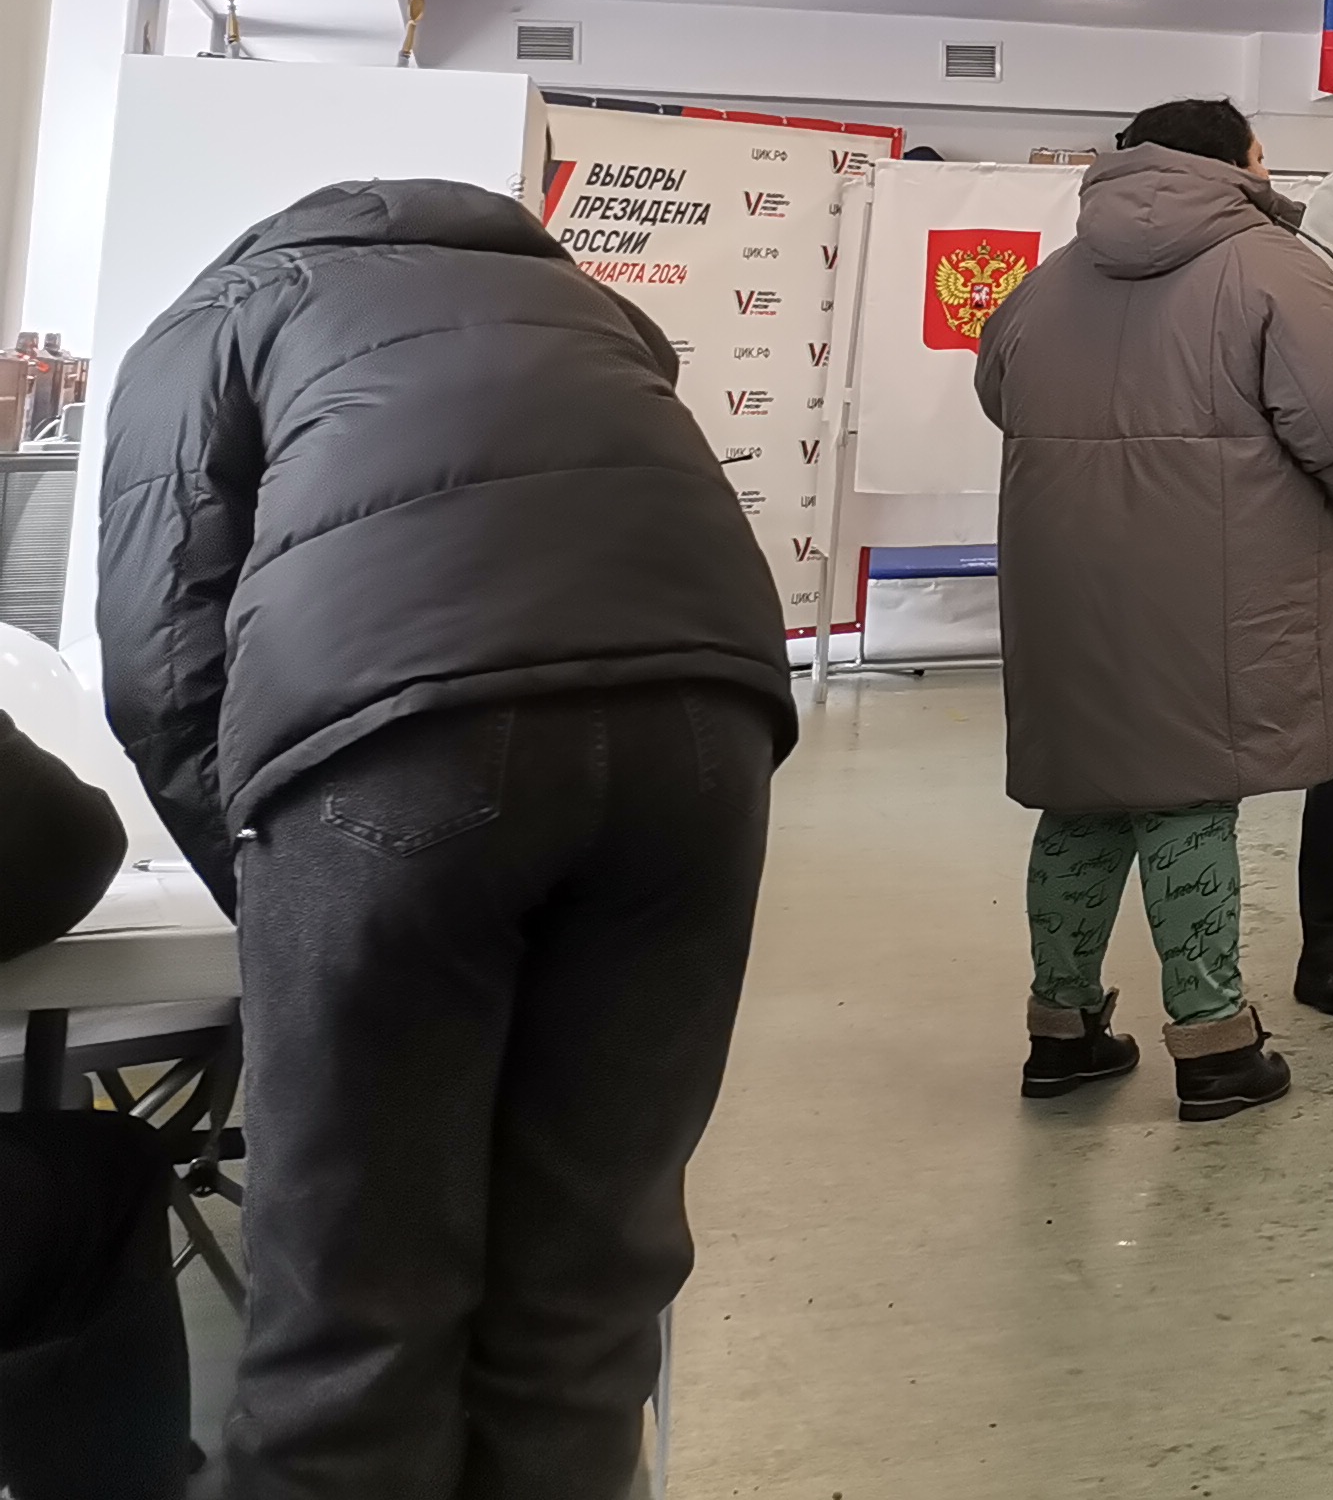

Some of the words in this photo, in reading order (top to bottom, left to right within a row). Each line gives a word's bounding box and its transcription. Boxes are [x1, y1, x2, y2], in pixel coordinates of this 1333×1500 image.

[585, 162, 687, 192] ВЫБОРЫ
[569, 195, 712, 227] ПРЕЗИДЕНТА
[559, 228, 652, 255] РОССИИ
[592, 261, 646, 284] МАРТА
[647, 263, 688, 284] 2024
[790, 591, 820, 605] ЦИК.Р
